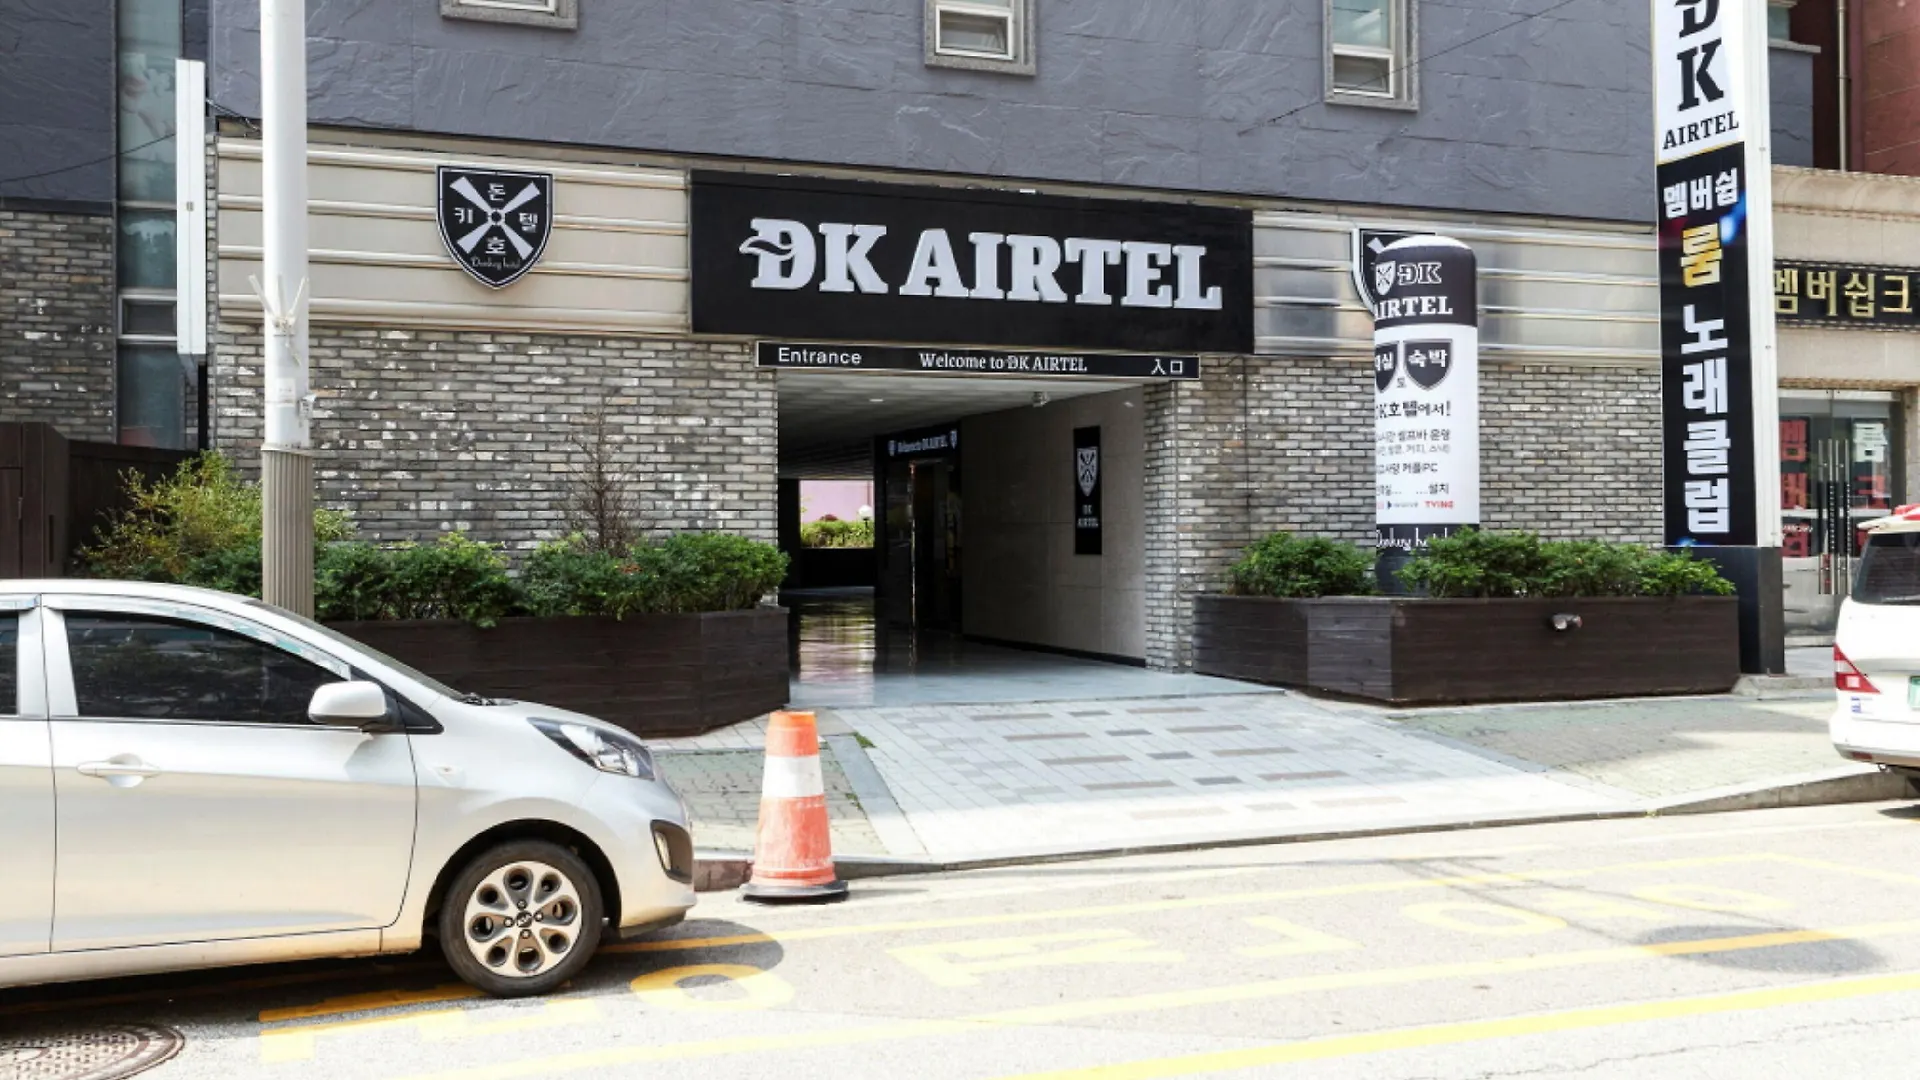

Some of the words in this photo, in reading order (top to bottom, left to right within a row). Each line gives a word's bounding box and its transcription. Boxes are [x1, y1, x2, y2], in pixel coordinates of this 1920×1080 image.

[1663, 110, 1740, 150] AIRTEL
[453, 207, 473, 224] 키
[1680, 222, 1724, 288] 룸
[899, 228, 1223, 310] AIRTEL
[778, 347, 862, 365] Entrance
[919, 352, 986, 370] Welcome
[990, 355, 1004, 369] to
[1032, 356, 1088, 372] AIRTEL
[1408, 348, 1448, 368] 숙박
[1151, 358, 1184, 376] 入口
[1375, 400, 1451, 419] K호텔에서!
[1681, 304, 1731, 533] 노래클럽
